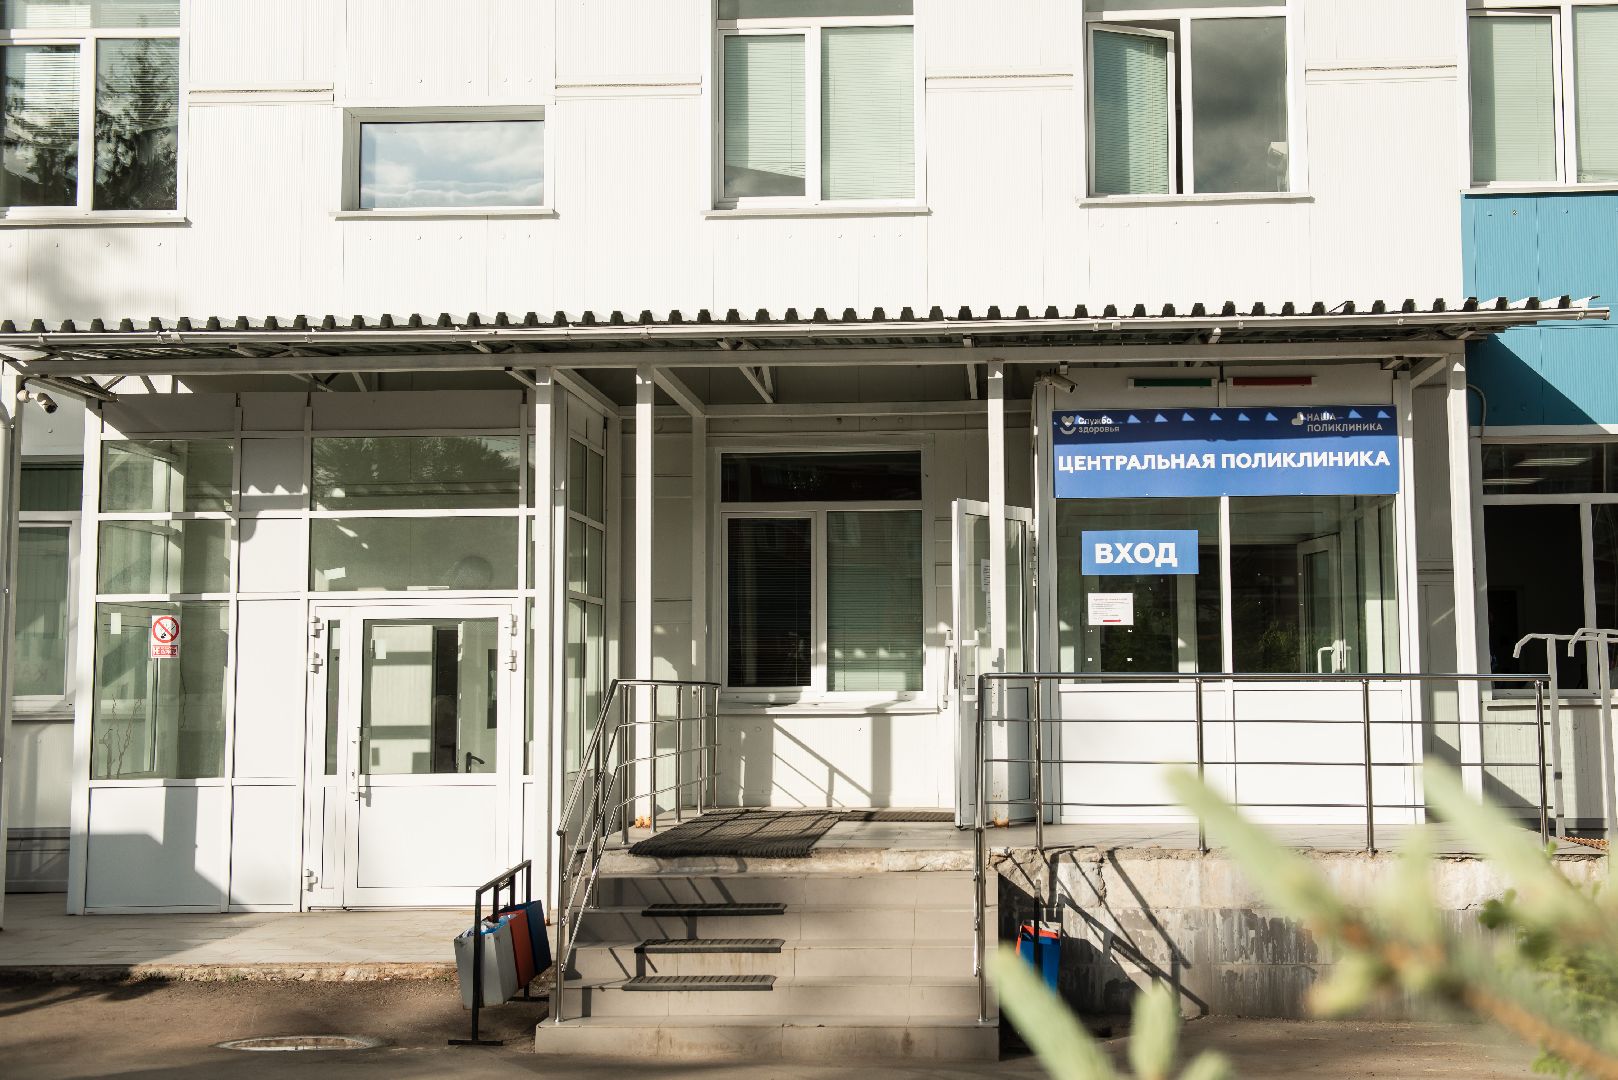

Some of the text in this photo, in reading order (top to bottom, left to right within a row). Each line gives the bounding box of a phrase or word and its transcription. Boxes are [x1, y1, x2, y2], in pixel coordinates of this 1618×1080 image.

[1078, 415, 1112, 426] Служба
[1306, 411, 1337, 422] НАША
[1078, 426, 1120, 435] здоровья
[1306, 422, 1383, 433] ПОЛИКЛИНИКА
[1058, 450, 1391, 474] ЦЕНТРАЛЬНАЯ ПОЛИКЛИНИКА
[1094, 542, 1178, 567] ВХОД
